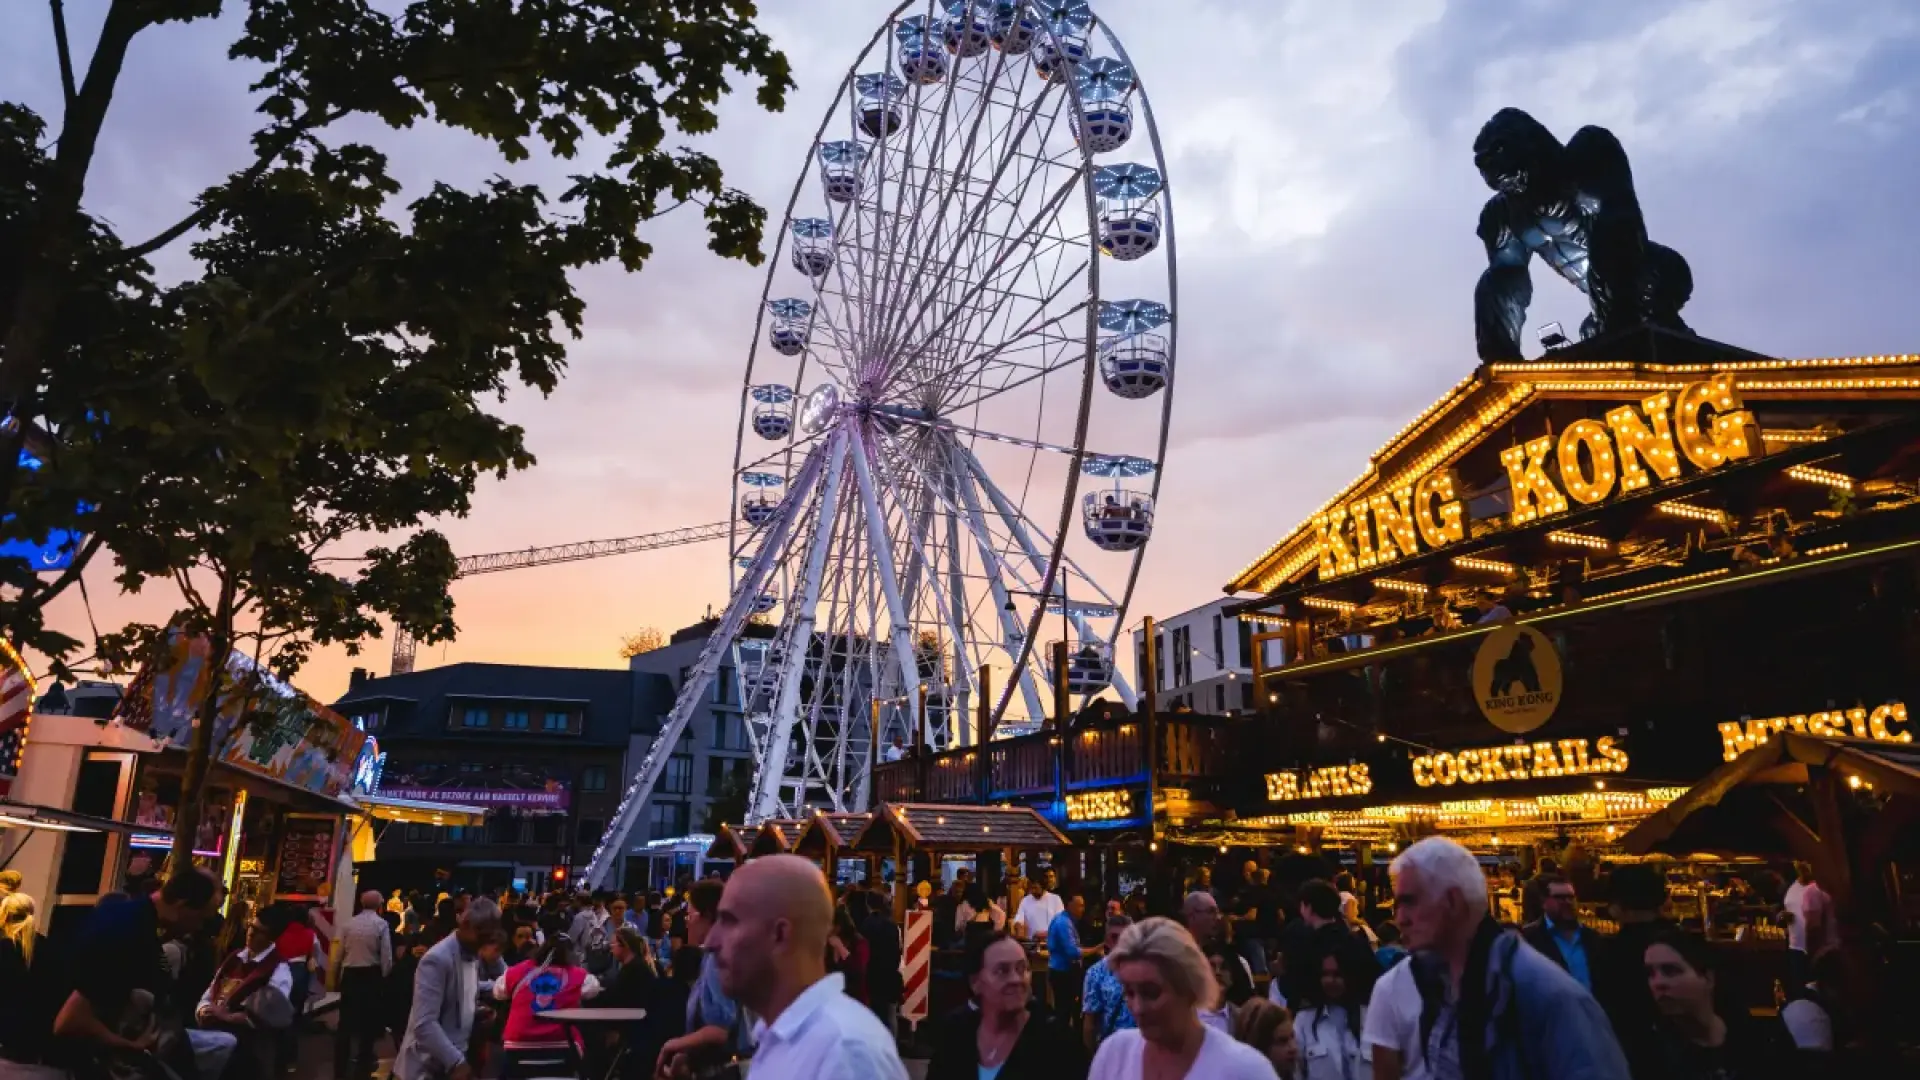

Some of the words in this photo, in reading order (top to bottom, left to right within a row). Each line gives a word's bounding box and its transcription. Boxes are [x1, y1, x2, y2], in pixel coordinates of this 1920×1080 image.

[1311, 468, 1466, 581] KING
[1500, 372, 1753, 526] KONG
[1486, 695, 1514, 709] KING
[1517, 691, 1553, 706] KONG
[1412, 735, 1629, 787] COCKTAILS
[1264, 763, 1373, 800] DRINKS
[1065, 789, 1131, 820] MUSIC
